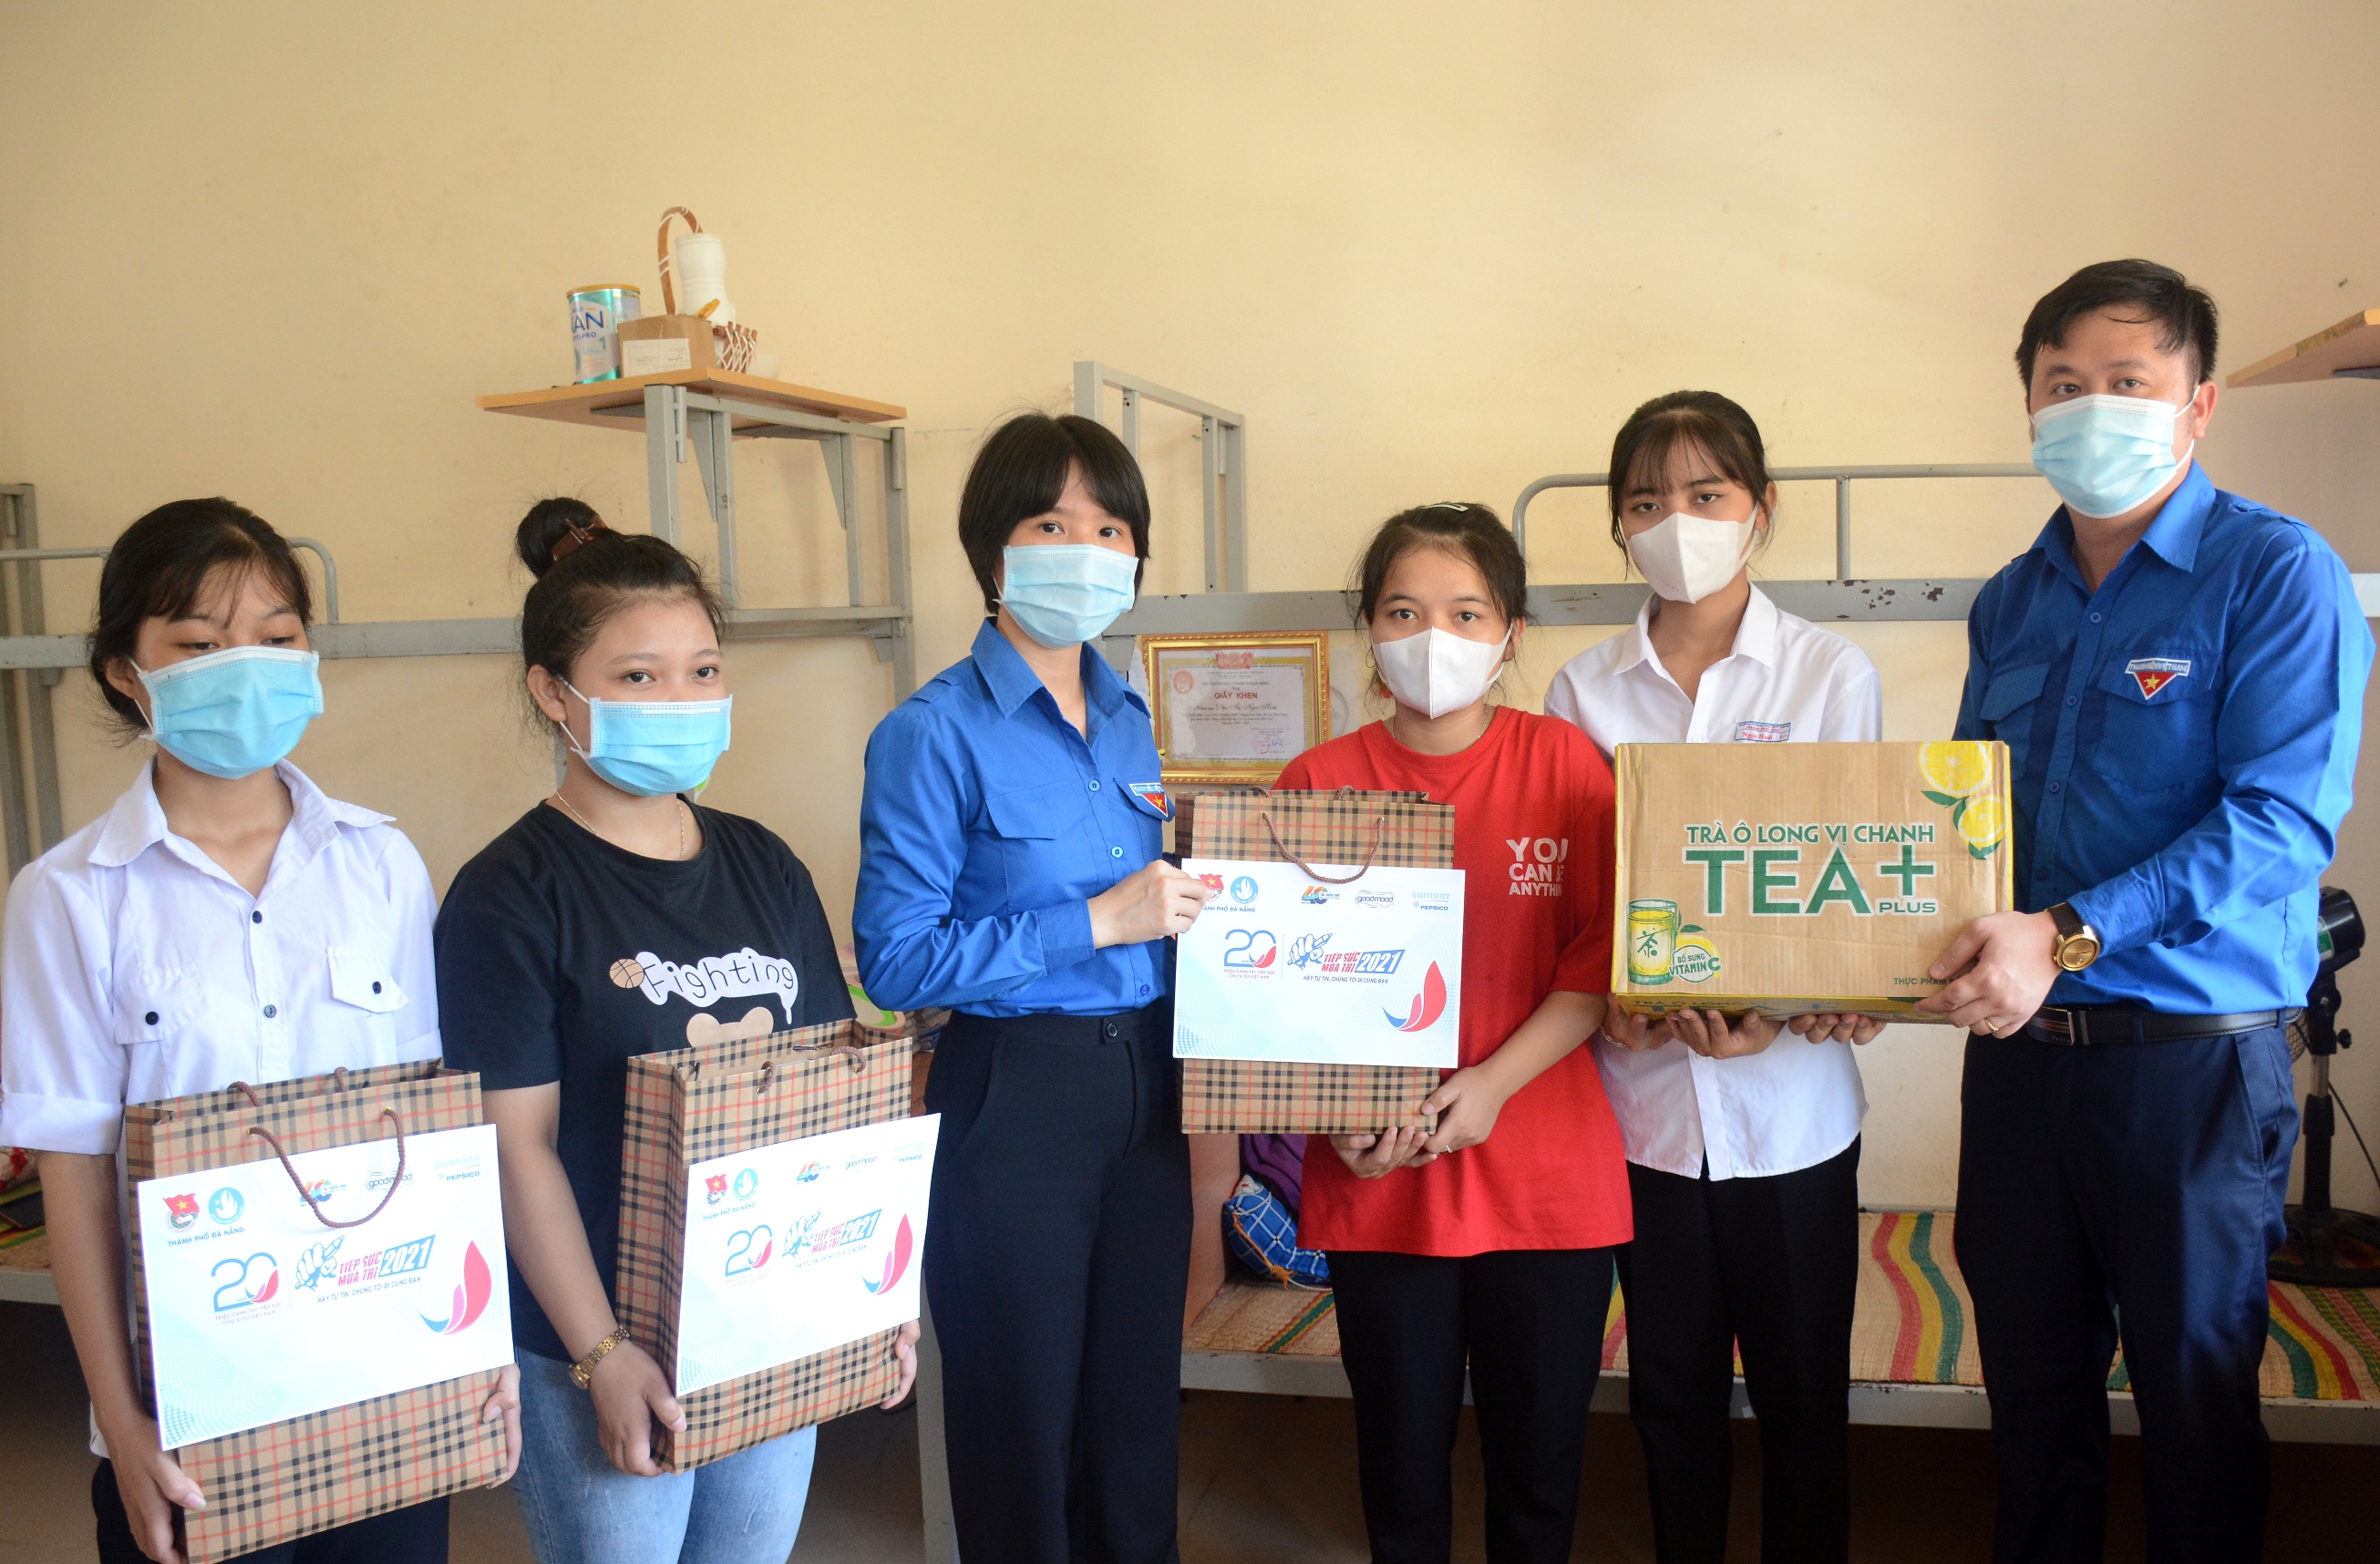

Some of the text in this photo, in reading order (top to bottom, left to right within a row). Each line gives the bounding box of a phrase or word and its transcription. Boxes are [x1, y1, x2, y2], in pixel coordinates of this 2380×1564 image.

[573, 331, 597, 342] PTIPRO
[1214, 690, 1233, 699] GIẤY
[1686, 821, 1934, 846] TRÀ Ô LONG VỊ CHANH
[1509, 863, 1552, 882] CAN
[1357, 894, 1394, 904] goodmood
[1412, 891, 1451, 900] SUNTORY
[1879, 902, 1936, 913] PLUS
[1356, 952, 1402, 972] 2021
[1677, 952, 1705, 963] BỔ SUNG
[1669, 957, 1721, 975] VITAMIN C
[644, 955, 794, 998] Fighting
[1894, 977, 1918, 987] THỰC
[446, 1170, 480, 1181] PEPSICO
[840, 1211, 879, 1244] 2021
[168, 1226, 245, 1247] THÀNH PHỐ ĐÀ NẴNG
[379, 1238, 432, 1276] 2021
